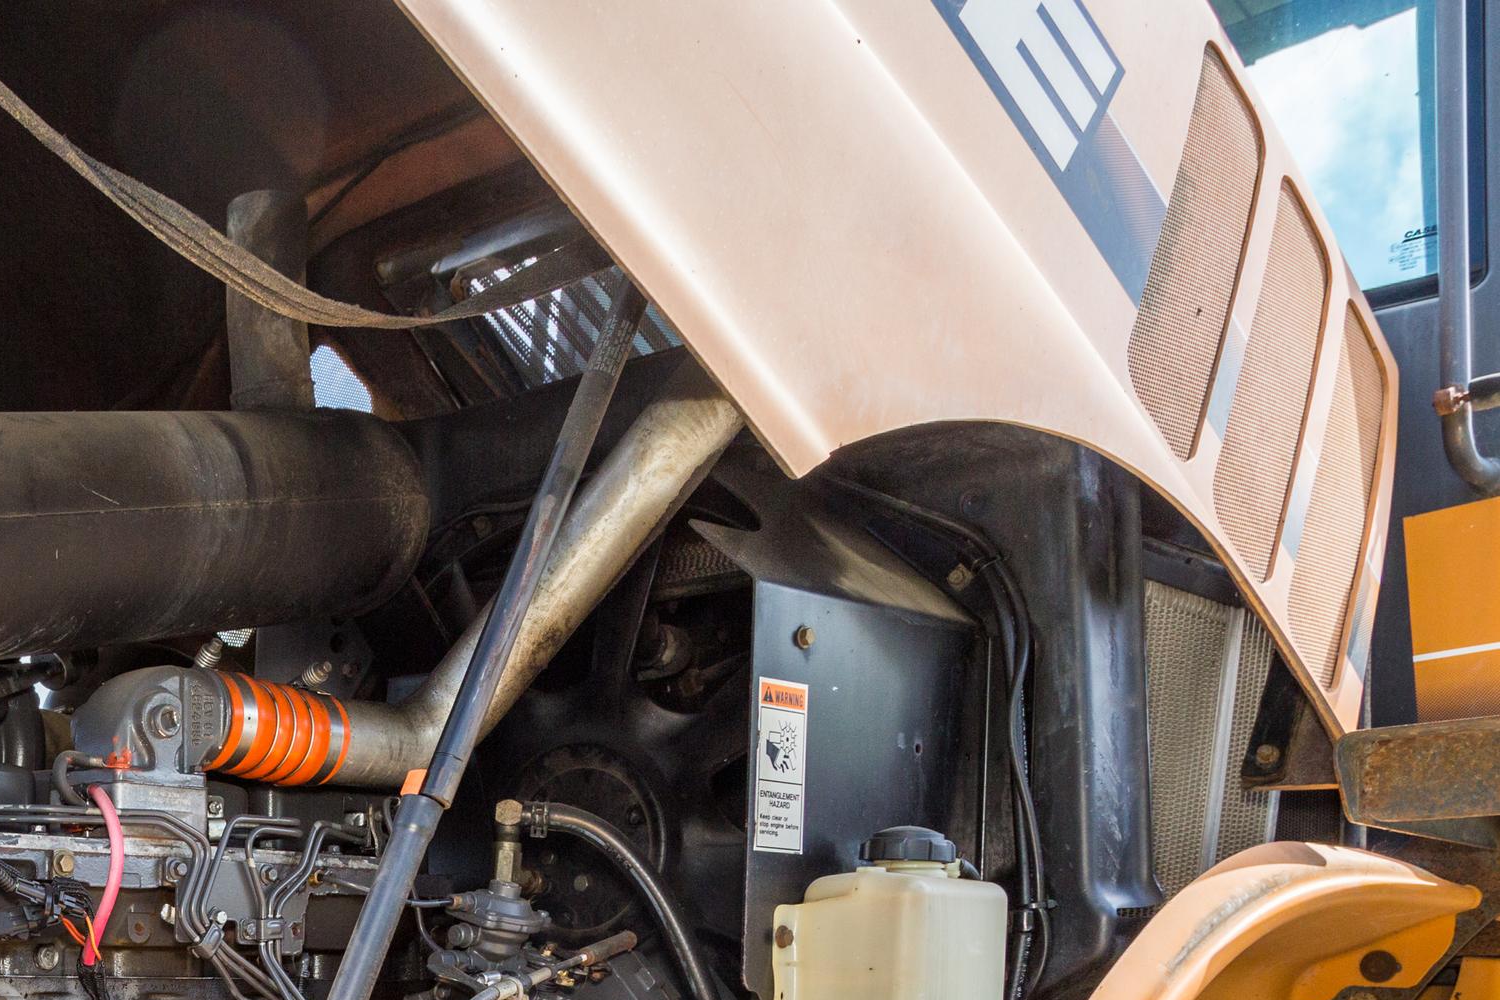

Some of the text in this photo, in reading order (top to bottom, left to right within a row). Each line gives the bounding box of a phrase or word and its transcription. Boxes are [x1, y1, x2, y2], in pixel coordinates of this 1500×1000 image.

[775, 690, 804, 707] WARNING
[759, 790, 800, 800] ENTANGLEMENT
[769, 800, 790, 809] HAZARD
